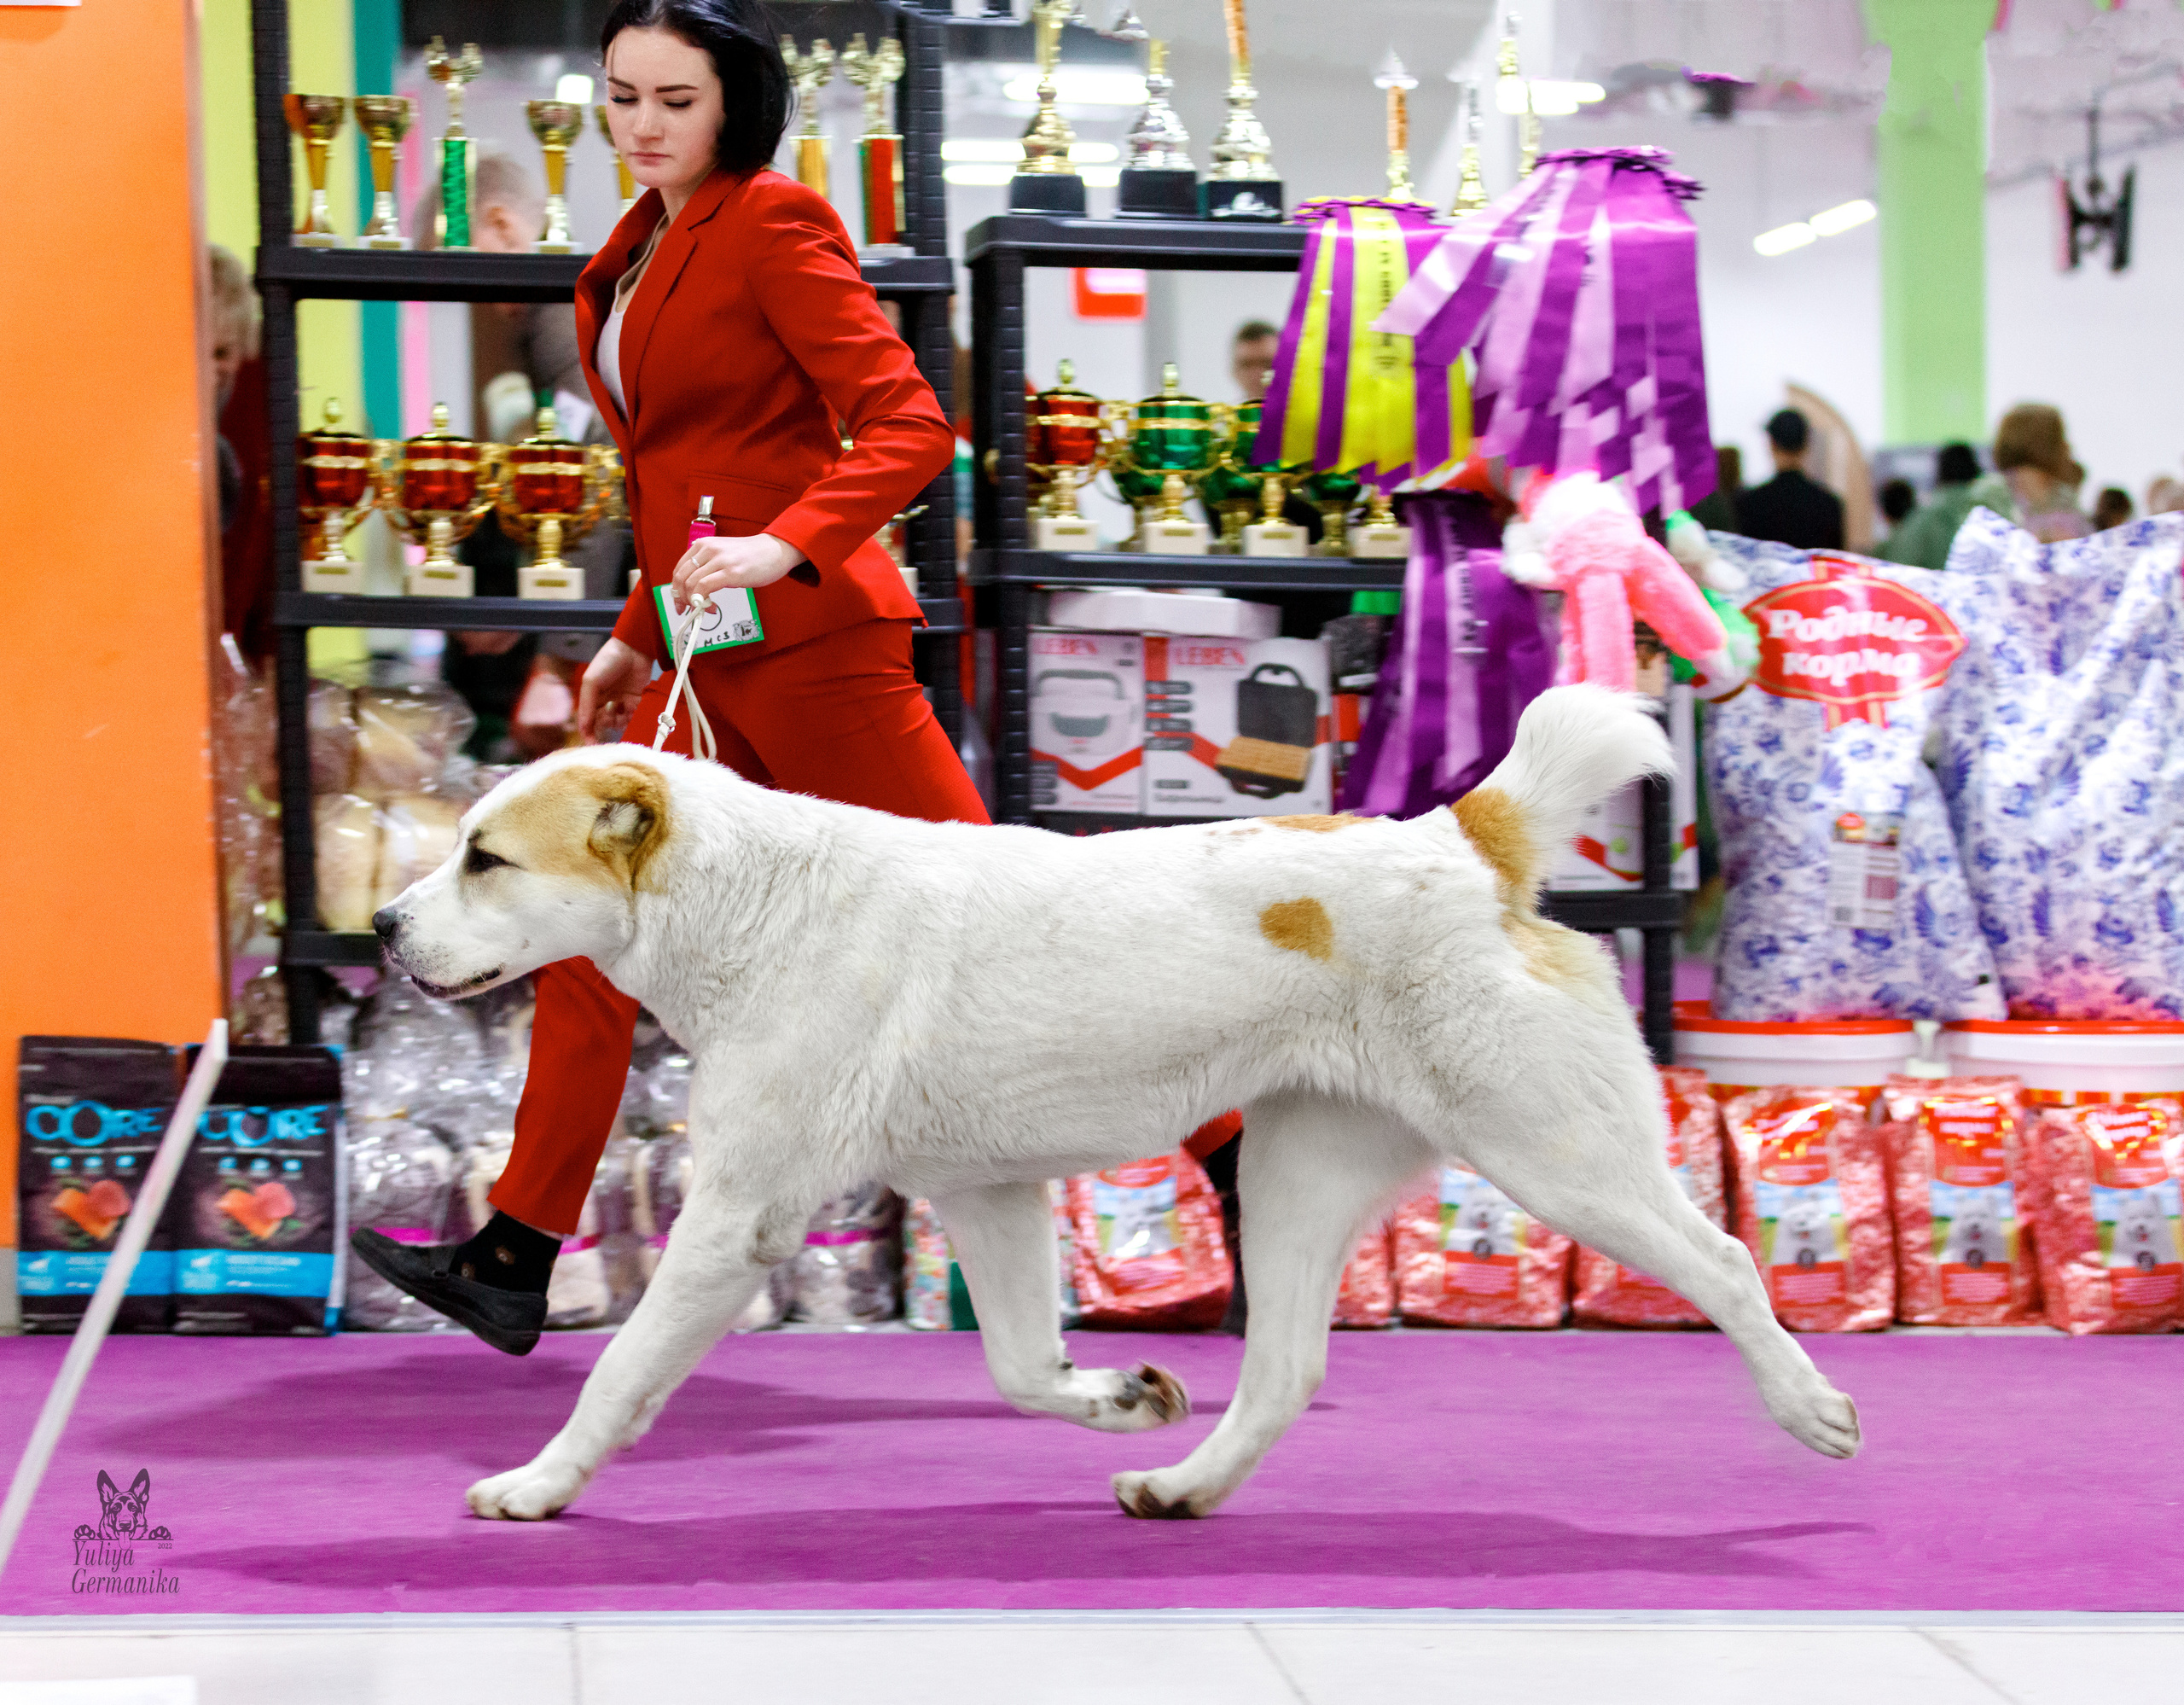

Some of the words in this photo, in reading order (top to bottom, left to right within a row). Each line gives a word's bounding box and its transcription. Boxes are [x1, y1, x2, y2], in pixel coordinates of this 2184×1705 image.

[1767, 605, 1927, 642] Родные
[1782, 648, 1920, 687] корма
[26, 1099, 164, 1147] CORE
